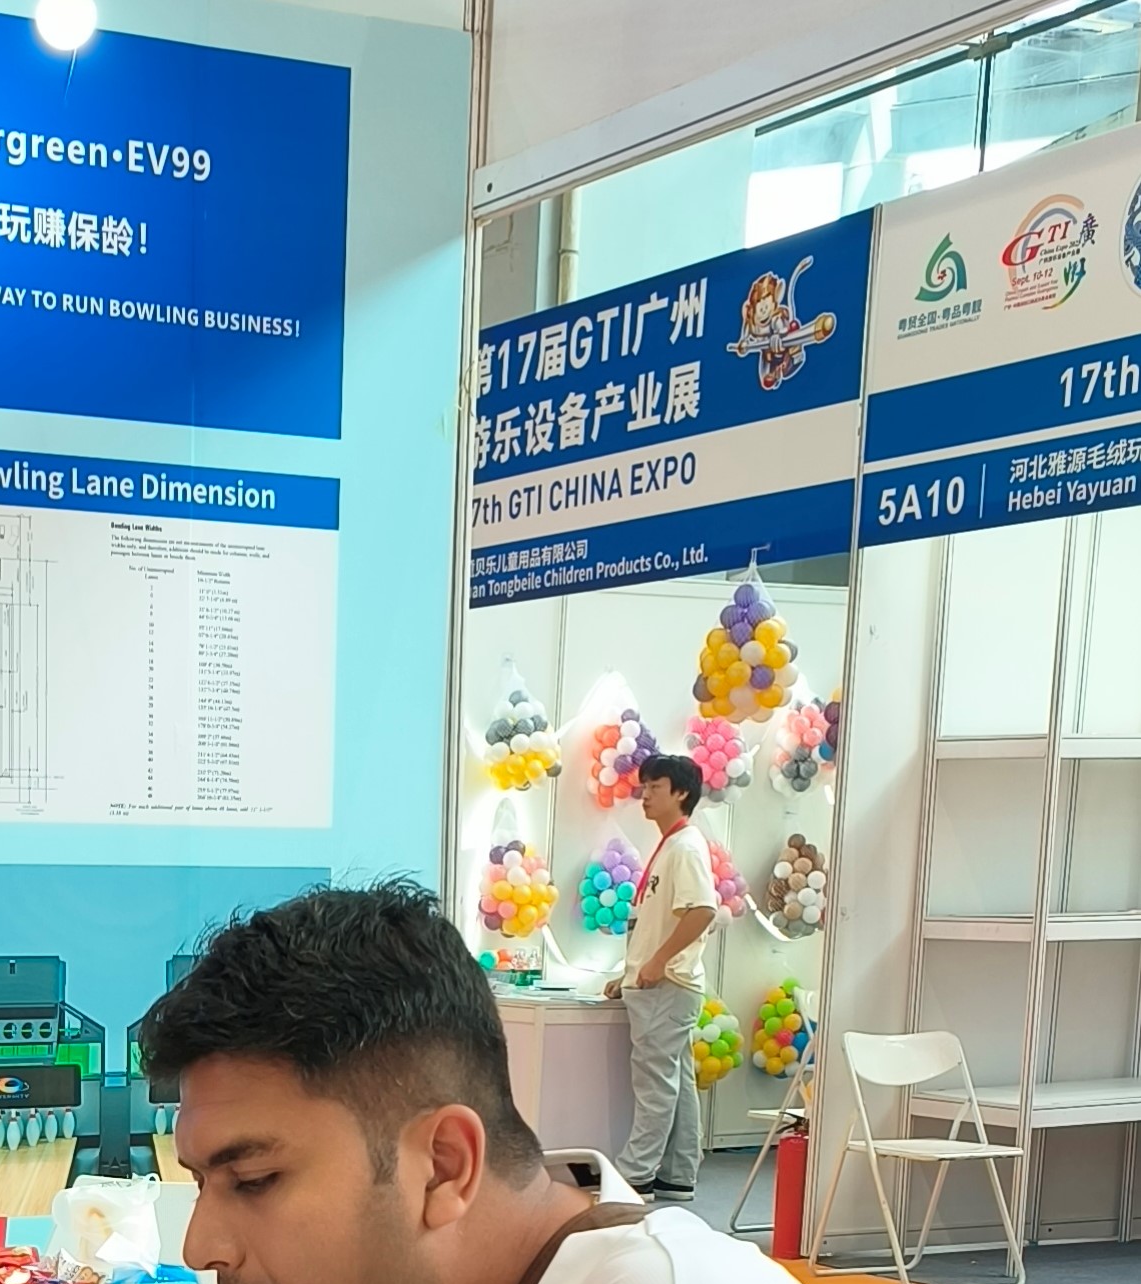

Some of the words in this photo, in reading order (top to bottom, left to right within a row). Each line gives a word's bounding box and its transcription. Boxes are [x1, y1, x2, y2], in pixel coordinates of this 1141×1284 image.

[32, 289, 57, 311] TO
[62, 292, 104, 317] RUN
[109, 297, 200, 328] BOWLING
[204, 310, 301, 339] BUSINESS!
[1060, 354, 1141, 408] 17th
[72, 467, 135, 499] Lane
[142, 473, 277, 510] Dimension
[508, 484, 543, 520] GTI
[549, 467, 623, 512] CHINA
[630, 451, 697, 496] EXPO
[878, 476, 965, 526] 5A10
[1008, 482, 1062, 513] Hebei
[1066, 474, 1137, 506] Yayuan
[487, 573, 542, 598] Tongbeile
[544, 564, 594, 588] Children
[596, 557, 652, 580] Products
[654, 551, 680, 571] Co.,
[682, 543, 709, 566] Ltd.
